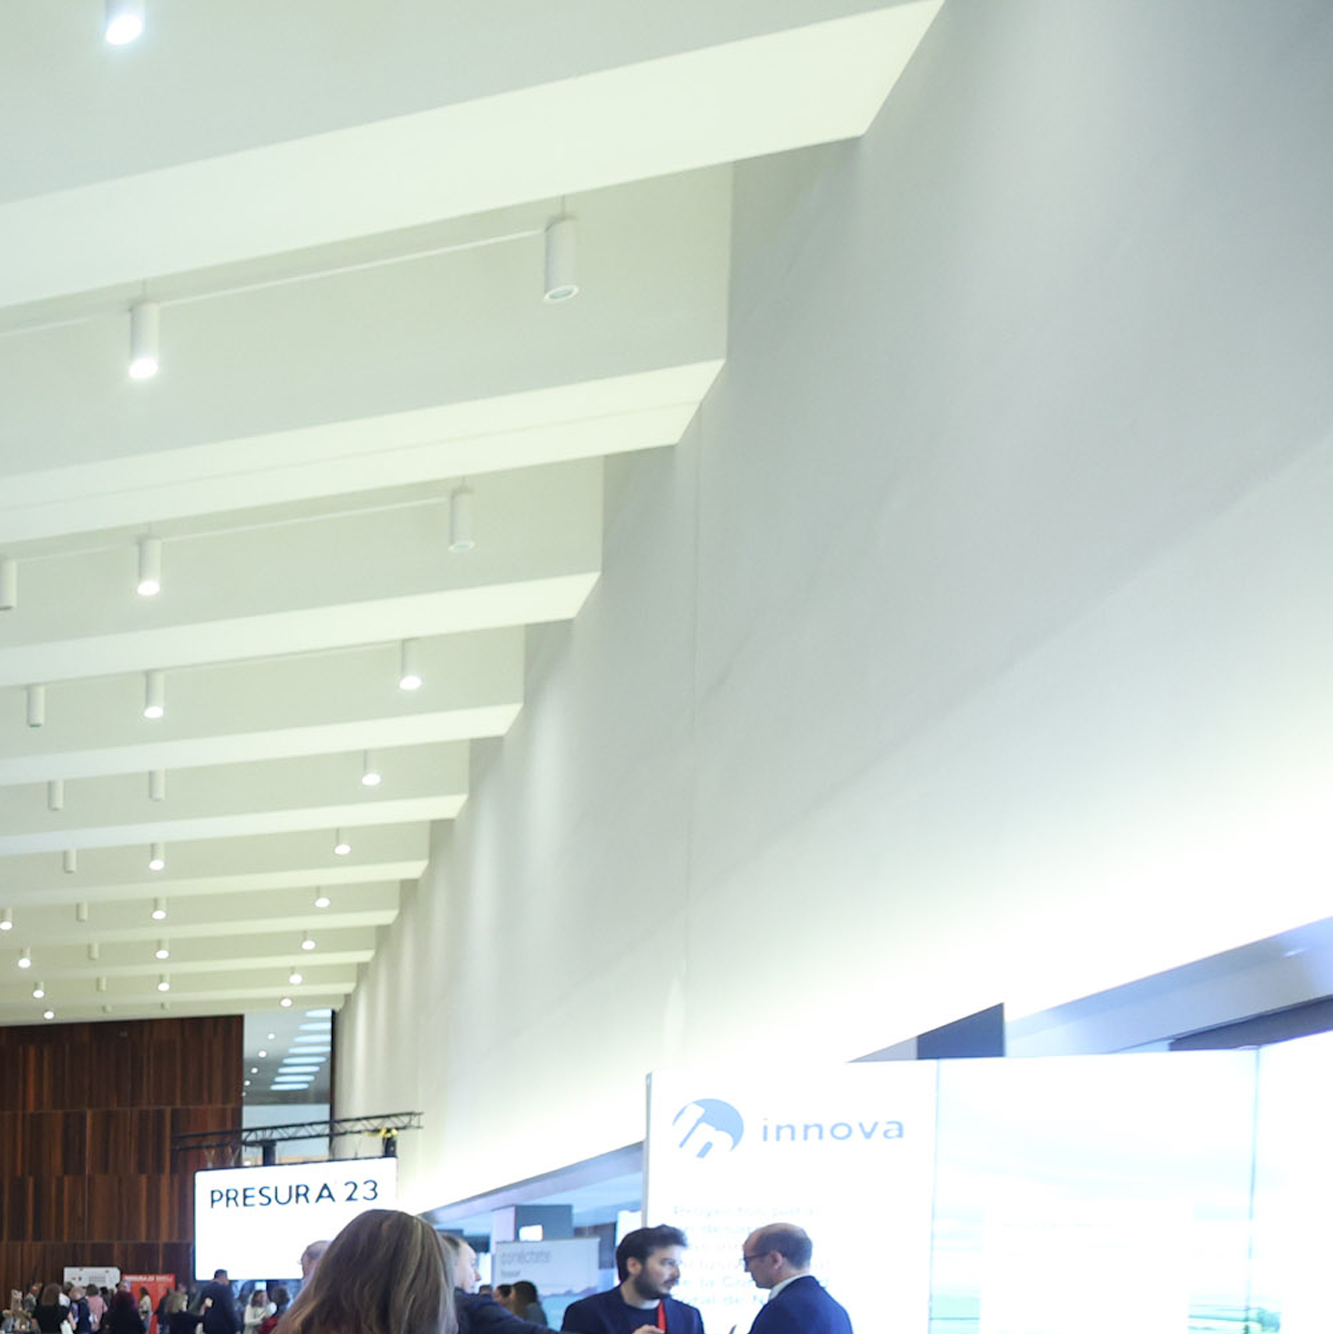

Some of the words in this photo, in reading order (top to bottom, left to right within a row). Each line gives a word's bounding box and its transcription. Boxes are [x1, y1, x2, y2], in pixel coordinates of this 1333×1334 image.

[762, 1117, 905, 1143] innova
[210, 1182, 336, 1209] PRESURA
[344, 1179, 379, 1202] 23
